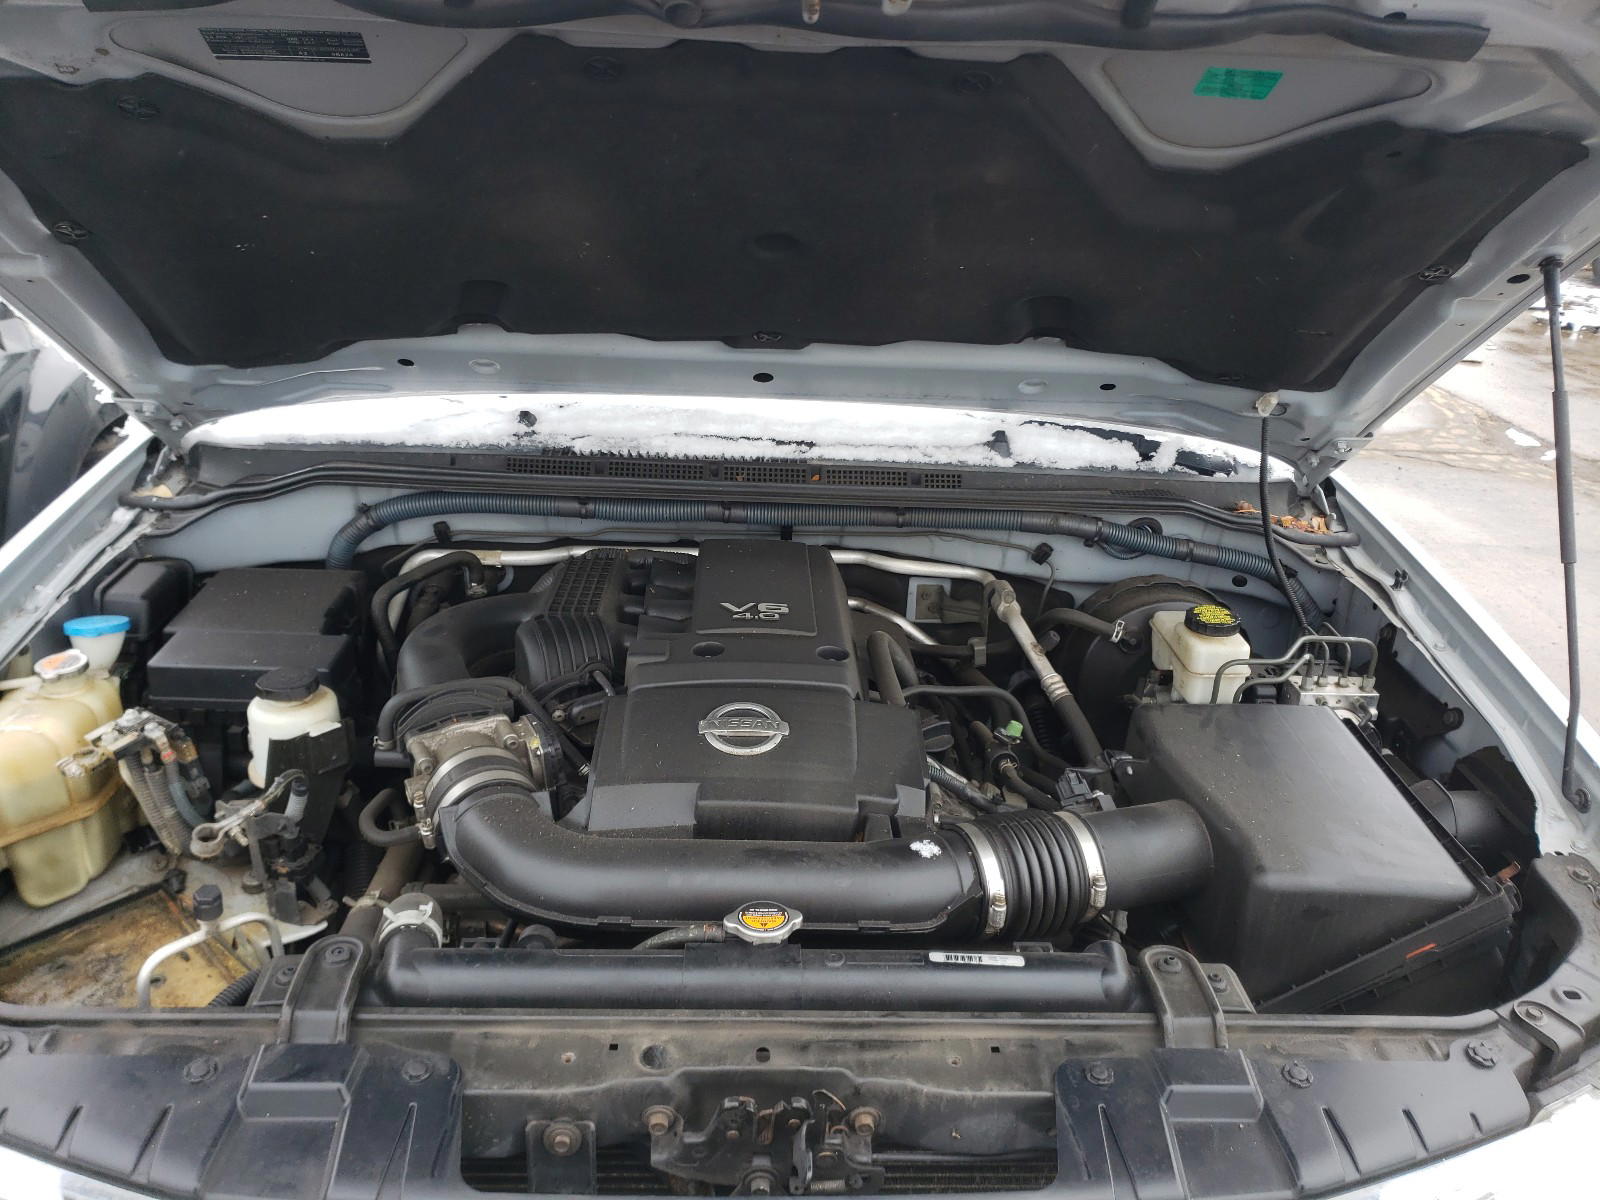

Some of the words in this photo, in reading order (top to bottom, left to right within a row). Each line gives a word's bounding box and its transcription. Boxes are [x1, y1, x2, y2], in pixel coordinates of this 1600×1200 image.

[720, 602, 789, 613] V6
[732, 612, 780, 620] 4.0
[710, 718, 780, 729] NISSAN
